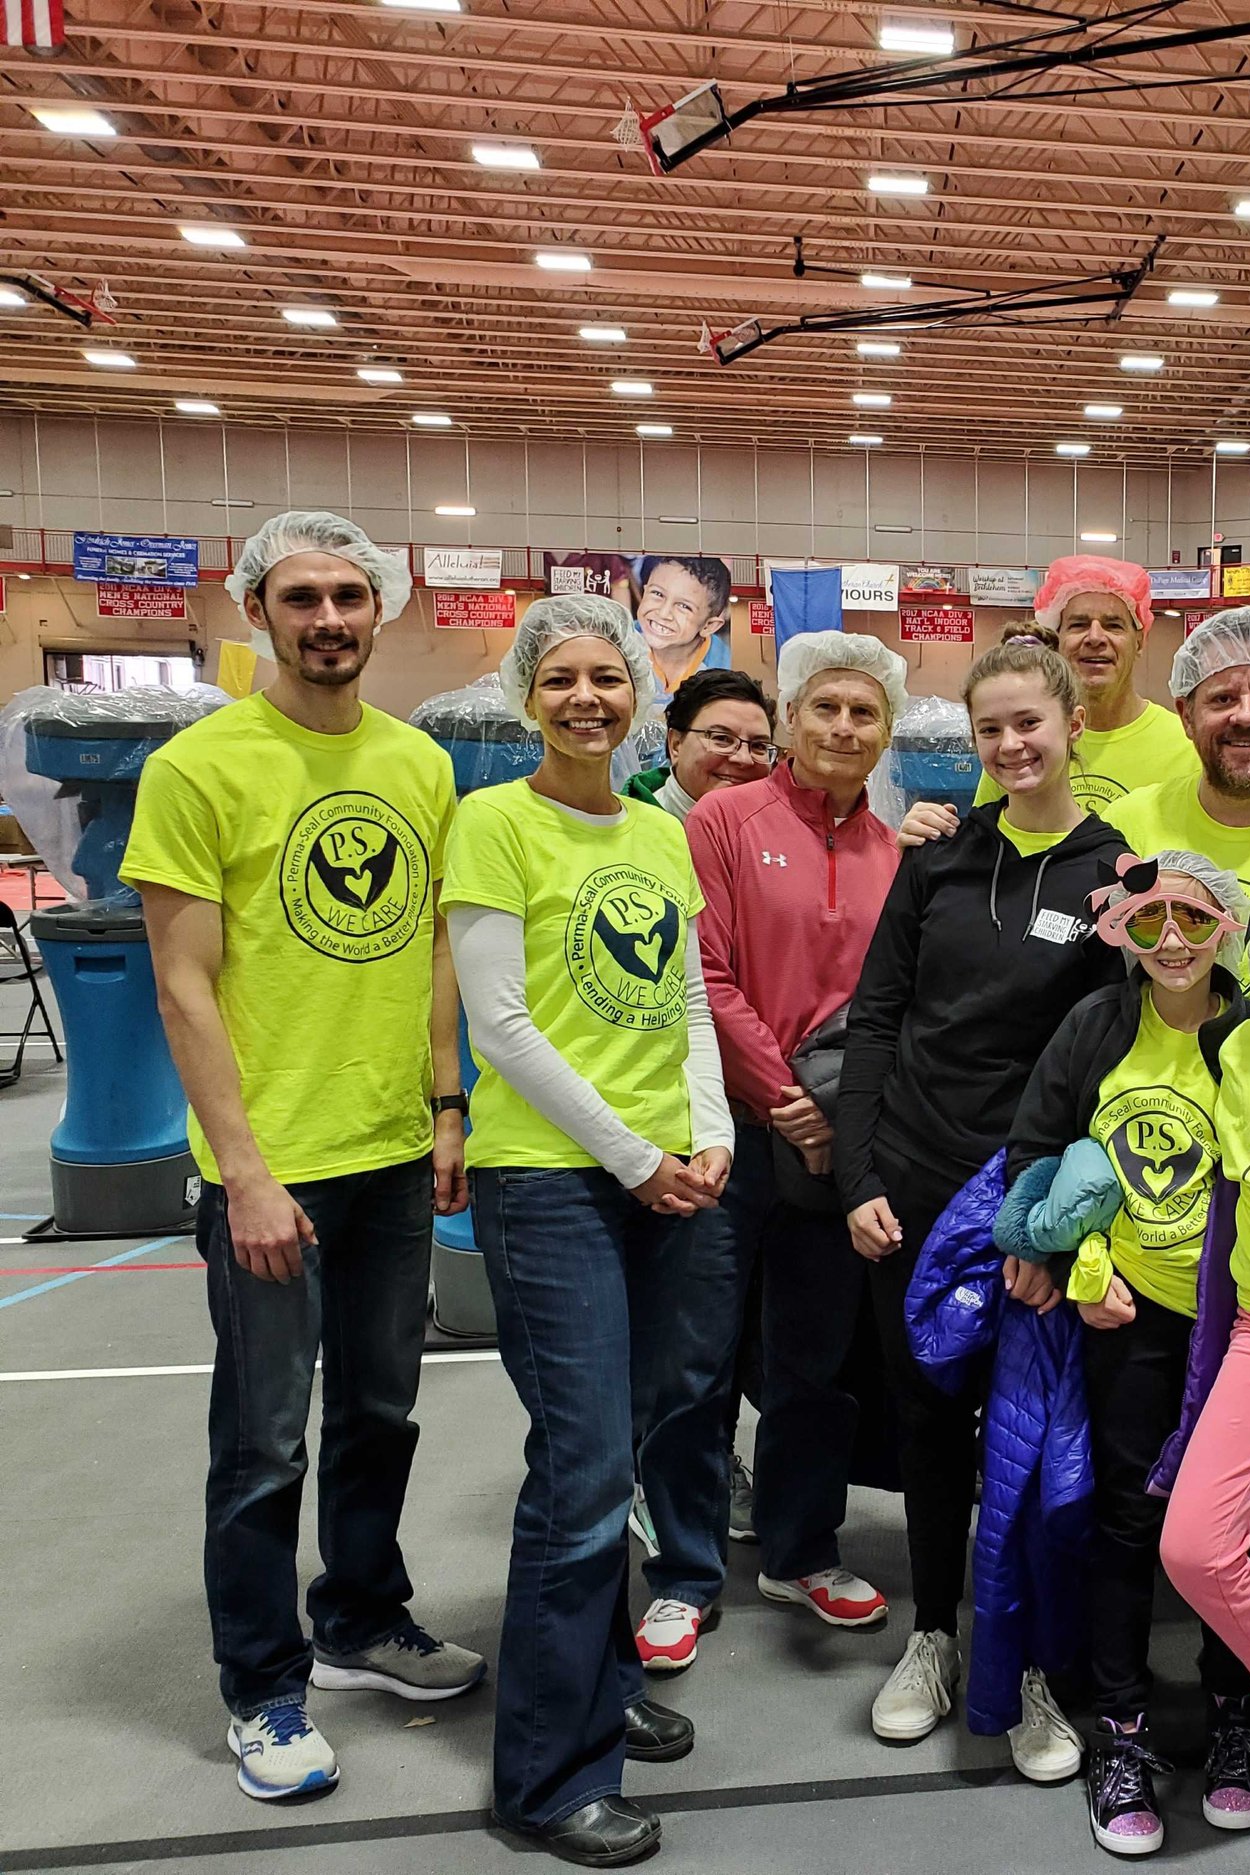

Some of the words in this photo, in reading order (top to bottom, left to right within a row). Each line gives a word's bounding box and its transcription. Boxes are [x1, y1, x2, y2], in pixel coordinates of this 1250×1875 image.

[428, 554, 484, 569] Alleluia!
[100, 590, 129, 599] MEN'S
[121, 584, 149, 592] NCAA
[842, 589, 894, 601] IOURS
[99, 599, 134, 607] CROSS
[437, 601, 464, 610] MEN'S
[468, 603, 513, 611] NATIONAL
[112, 608, 172, 616] CHAMPIONS
[470, 611, 514, 619] COUNTRY
[449, 619, 503, 627] CHAMPIONS
[752, 618, 775, 626] CROS
[912, 633, 962, 641] CHAMPIONS
[1071, 783, 1116, 799] ommunity
[287, 818, 320, 883] Perma-Seal
[319, 804, 385, 821] Community
[385, 816, 420, 879] Foundation
[327, 826, 376, 862] P.S.
[328, 905, 357, 932] WE
[362, 897, 404, 932] CARE
[572, 885, 599, 961] Perma-Seal
[593, 870, 656, 889] Community
[606, 891, 659, 927] P.S.
[292, 897, 319, 941] Making
[320, 935, 340, 951] the
[373, 943, 381, 951] a
[382, 921, 412, 948] Better
[617, 977, 647, 1006] WE
[653, 966, 684, 1005] CARE
[581, 972, 624, 1024] Lending
[626, 1014, 635, 1024] a
[642, 1003, 683, 1028] Helping
[1133, 1096, 1194, 1124] Community
[1136, 1121, 1182, 1151] P.S.
[1170, 1231, 1177, 1240] a
[1179, 1213, 1207, 1236] Better
